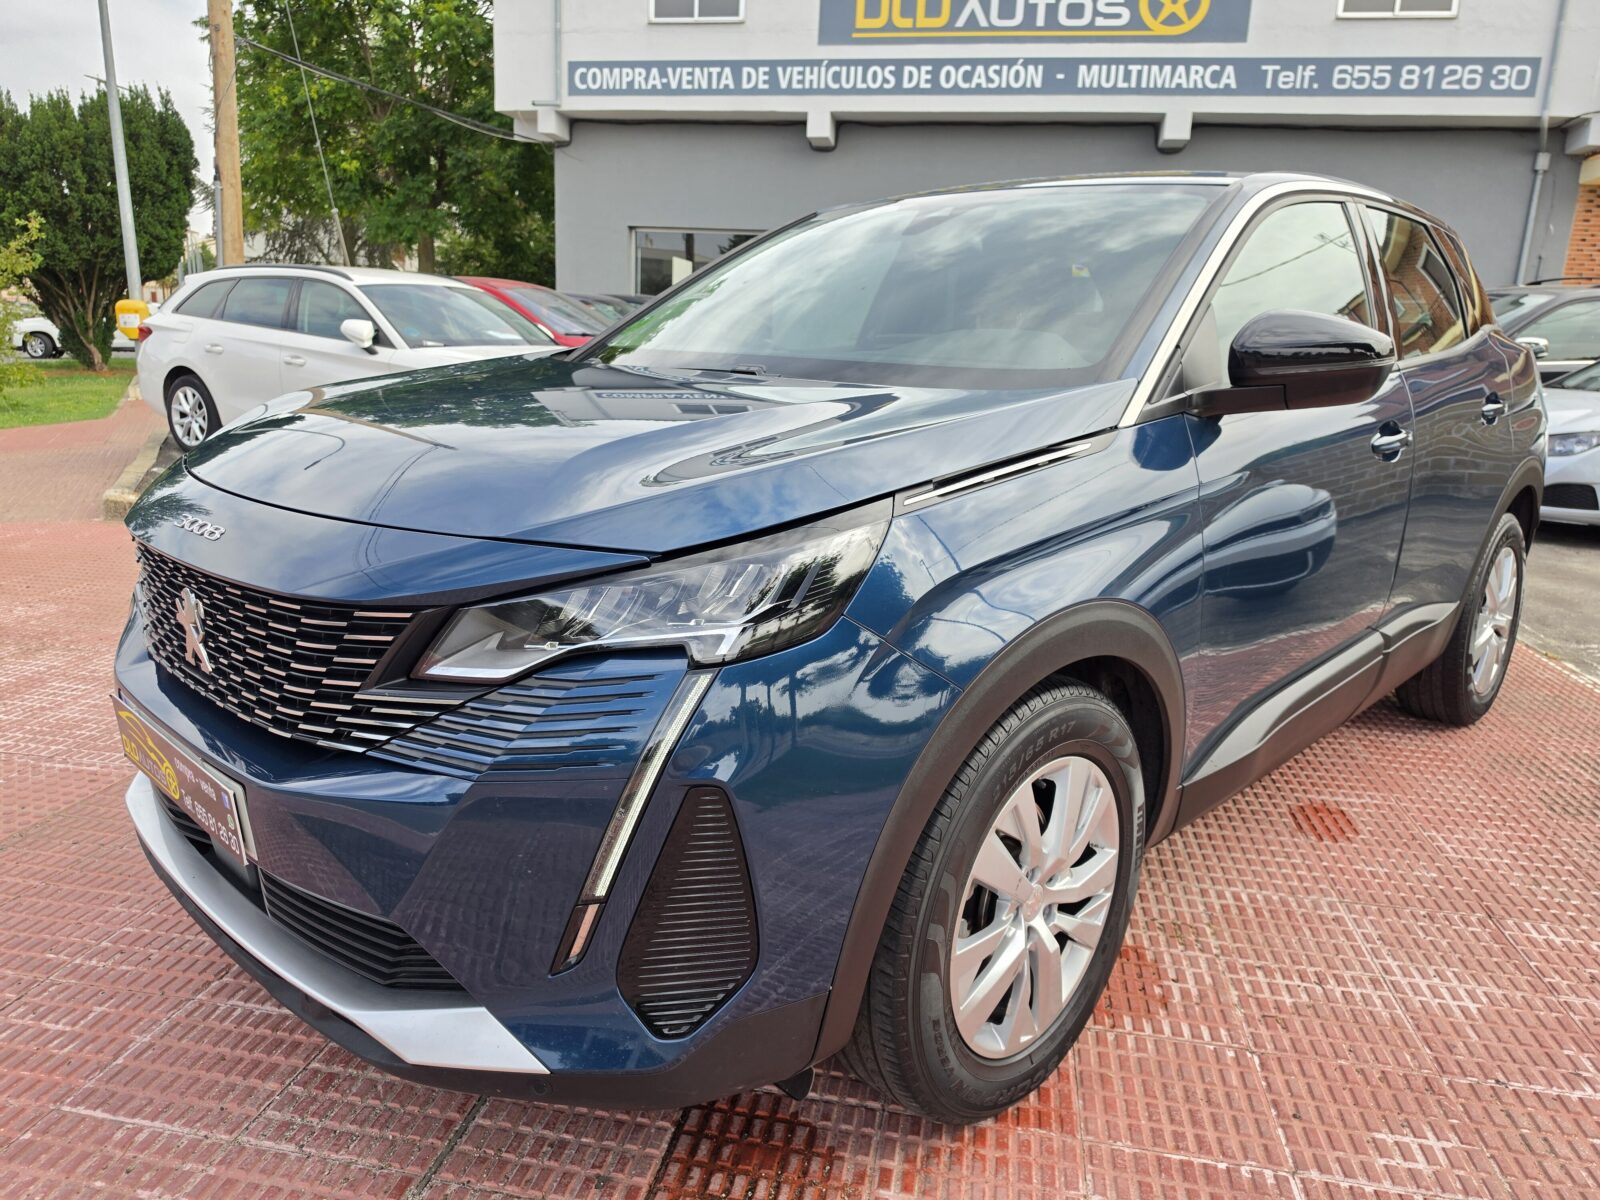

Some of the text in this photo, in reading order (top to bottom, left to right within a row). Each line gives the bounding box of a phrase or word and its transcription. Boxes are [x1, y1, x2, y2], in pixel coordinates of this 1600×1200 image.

[573, 66, 735, 90] COMPRA-VENTA
[741, 66, 770, 90] DE
[776, 60, 896, 90] VEHÍCULOS
[902, 65, 933, 89] DE
[939, 58, 1044, 89] OCASIÓN
[1076, 64, 1238, 89] MULTIMARCA
[1260, 65, 1320, 90] Telf.
[1331, 64, 1393, 90] 655
[1489, 64, 1533, 91] 30
[173, 513, 226, 541] 3008
[1048, 720, 1076, 742] R17
